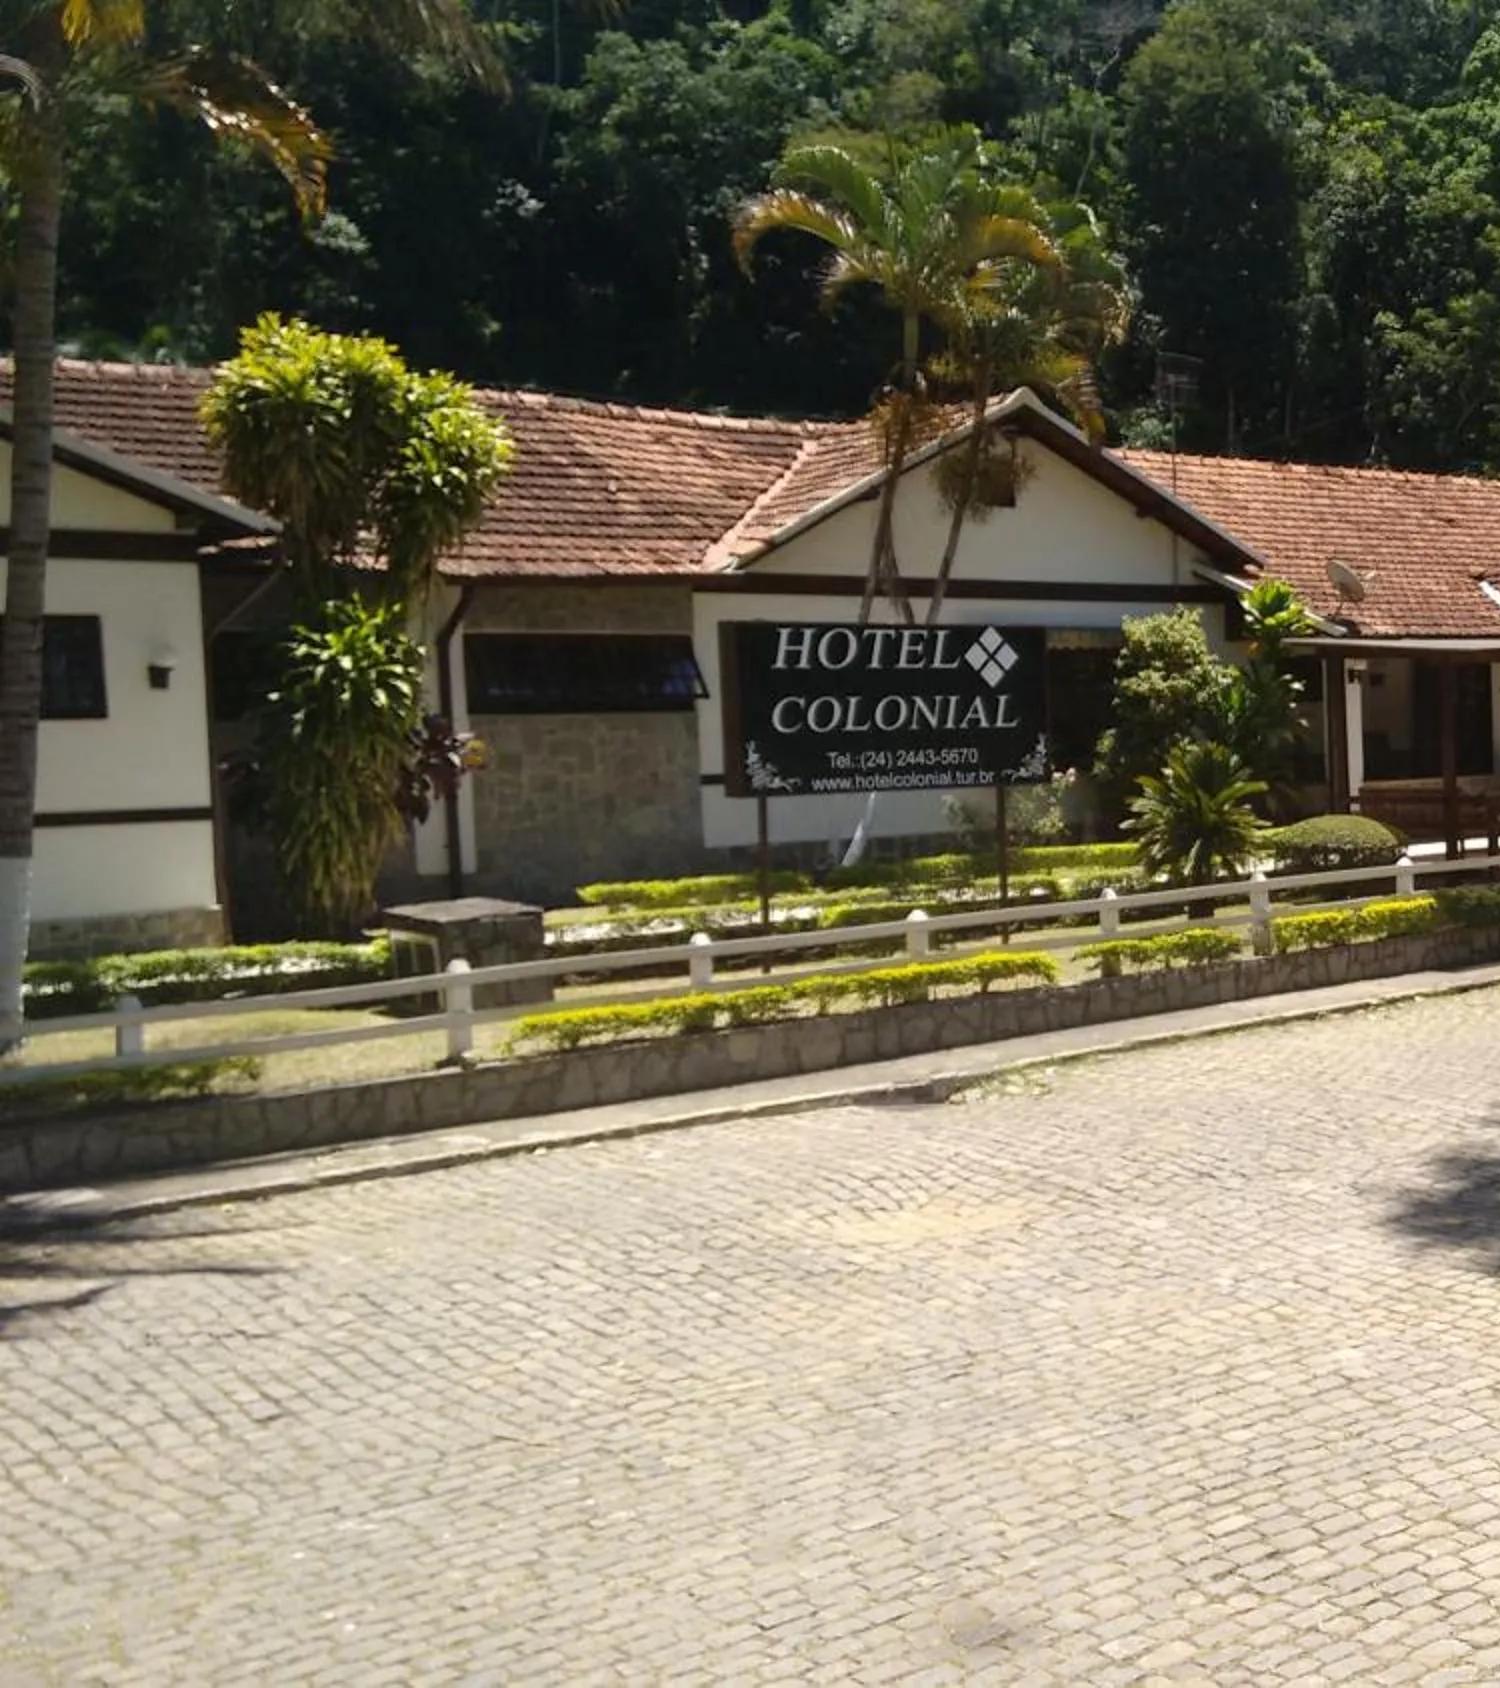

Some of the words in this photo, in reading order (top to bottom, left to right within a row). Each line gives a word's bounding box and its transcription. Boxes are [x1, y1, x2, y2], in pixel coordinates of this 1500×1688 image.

[771, 627, 960, 670] HOTEL
[771, 695, 1019, 733] COLONIAL
[896, 748, 979, 767] 2443-5670
[811, 770, 995, 792] www.hotelcolonial.tur.br
